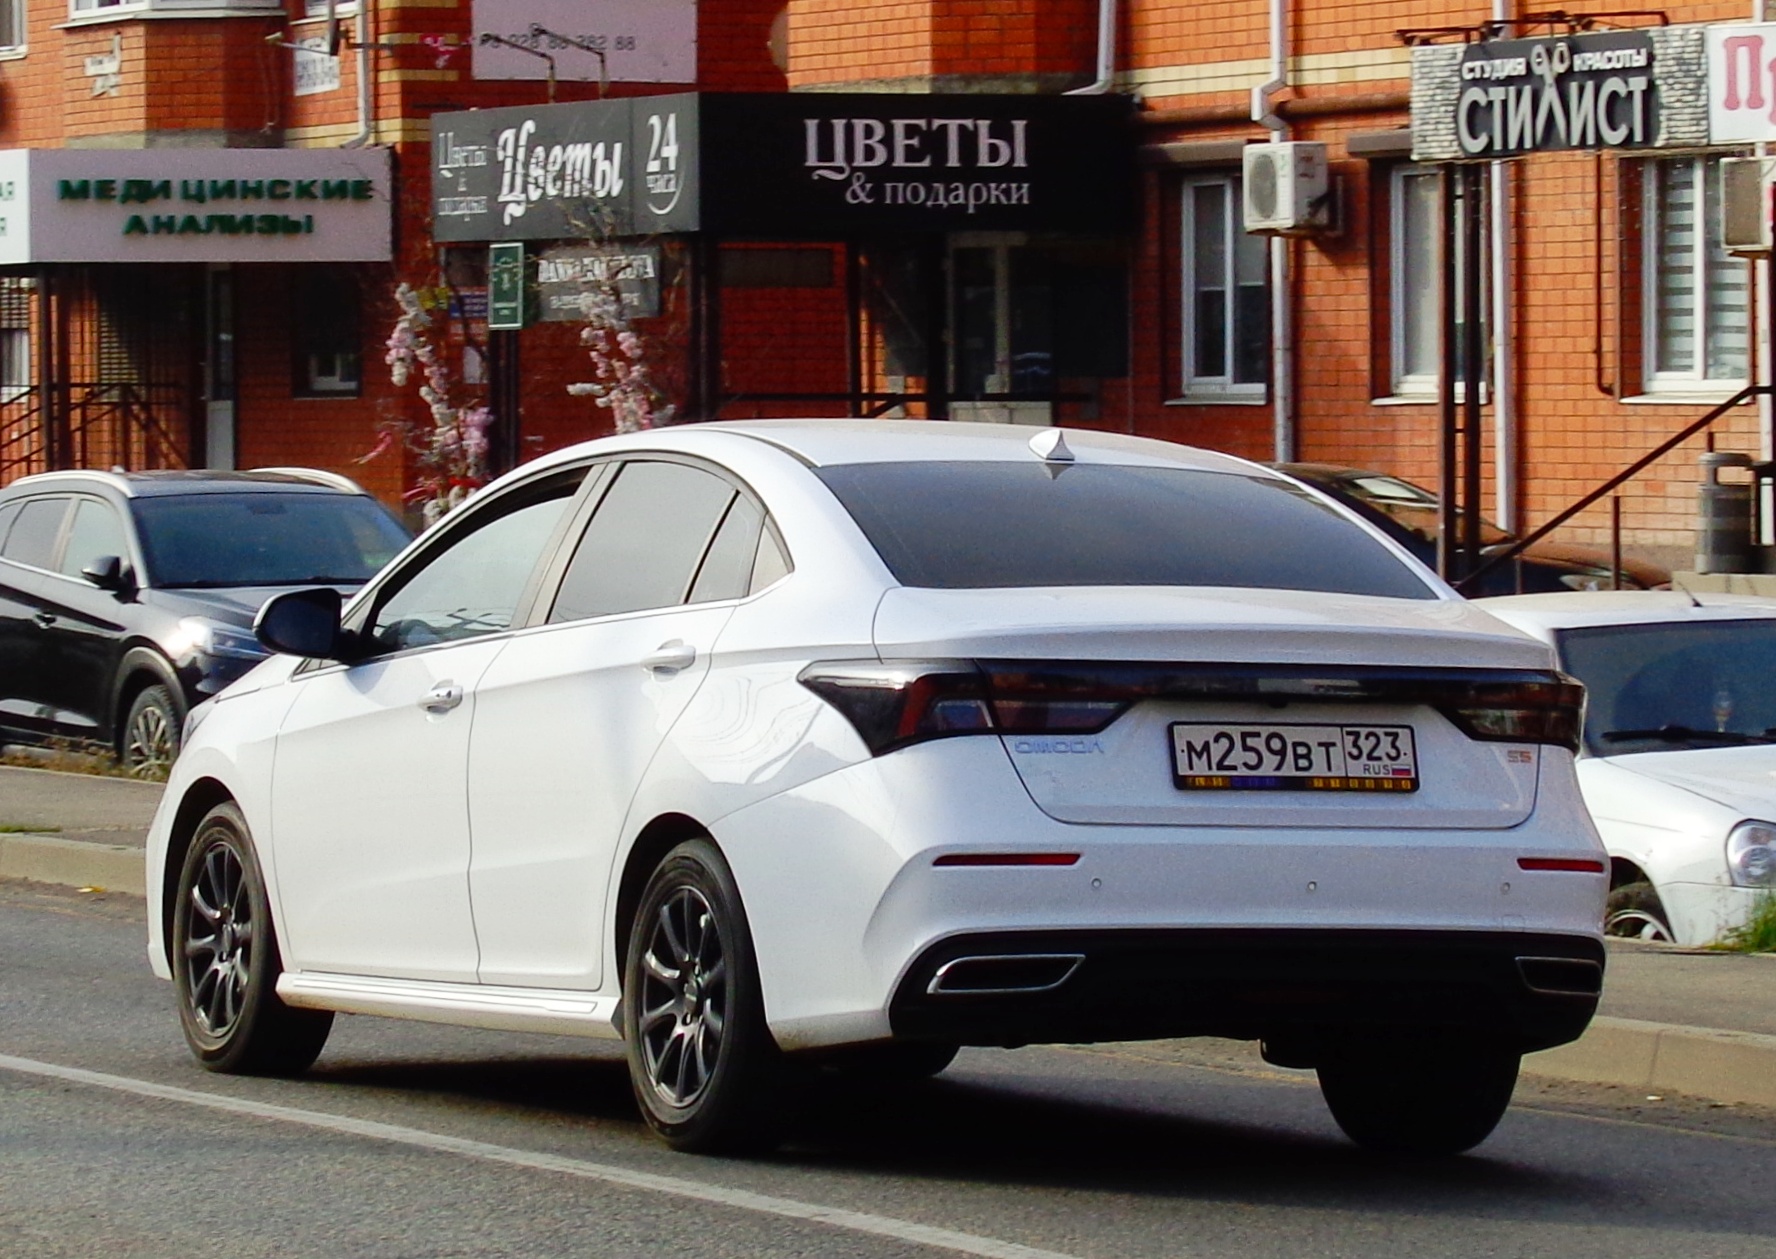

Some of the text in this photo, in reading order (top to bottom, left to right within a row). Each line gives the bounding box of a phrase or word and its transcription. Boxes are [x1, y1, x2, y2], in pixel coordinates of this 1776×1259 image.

[1461, 48, 1648, 81] СТУДИЯ КРАСОТЫ
[1723, 35, 1776, 125] П
[1457, 76, 1648, 153] СТИЛИСТ
[646, 113, 679, 173] 24
[803, 118, 1028, 181] ЦВЕТЫ
[58, 179, 374, 203] МЕДИЦИНСКИЕ
[497, 119, 624, 226] Цветы
[845, 171, 1030, 214] & подарки
[123, 214, 313, 235] АНАЛИЗЫ
[1185, 730, 1401, 772] М259ВТ 323
[1362, 763, 1391, 775] RUS
